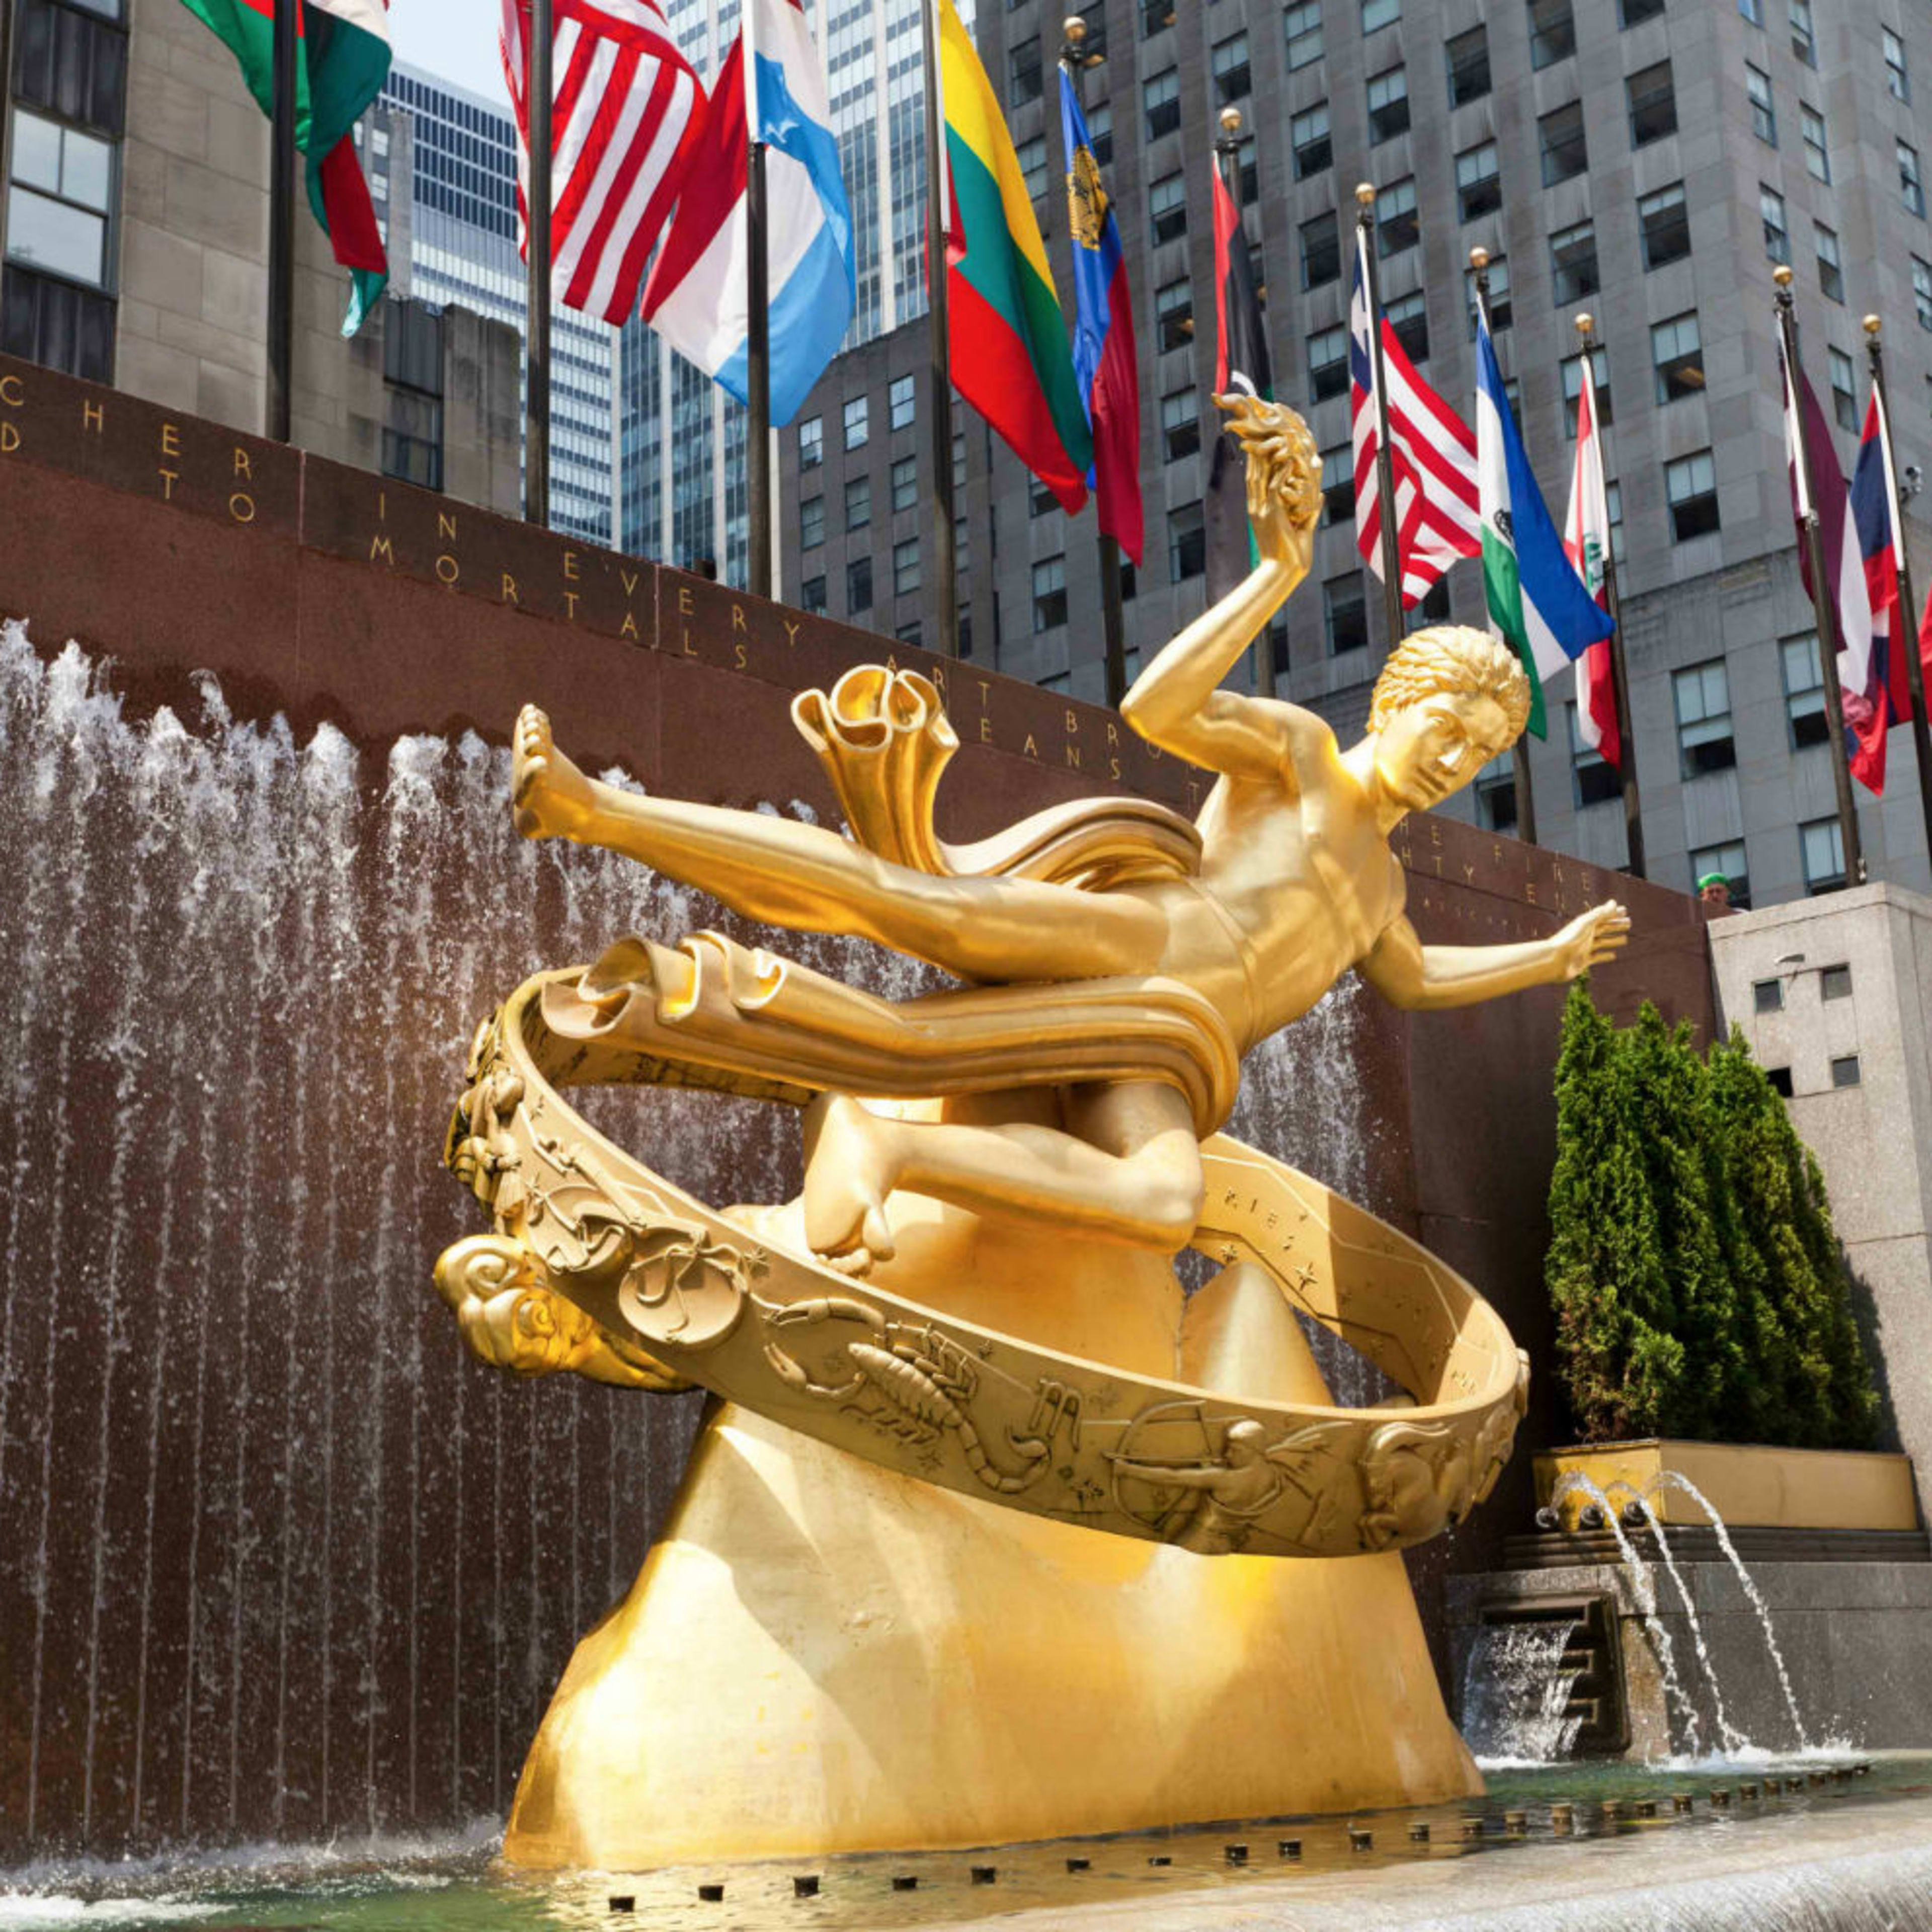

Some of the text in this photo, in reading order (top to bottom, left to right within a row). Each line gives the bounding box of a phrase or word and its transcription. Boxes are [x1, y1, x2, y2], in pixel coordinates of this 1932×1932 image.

[1, 375, 252, 480] CHER
[378, 492, 458, 541] IN
[564, 551, 800, 647] EVERY
[158, 469, 255, 523] TO
[370, 535, 747, 669] MORTALS
[981, 717, 1121, 780] EANS
